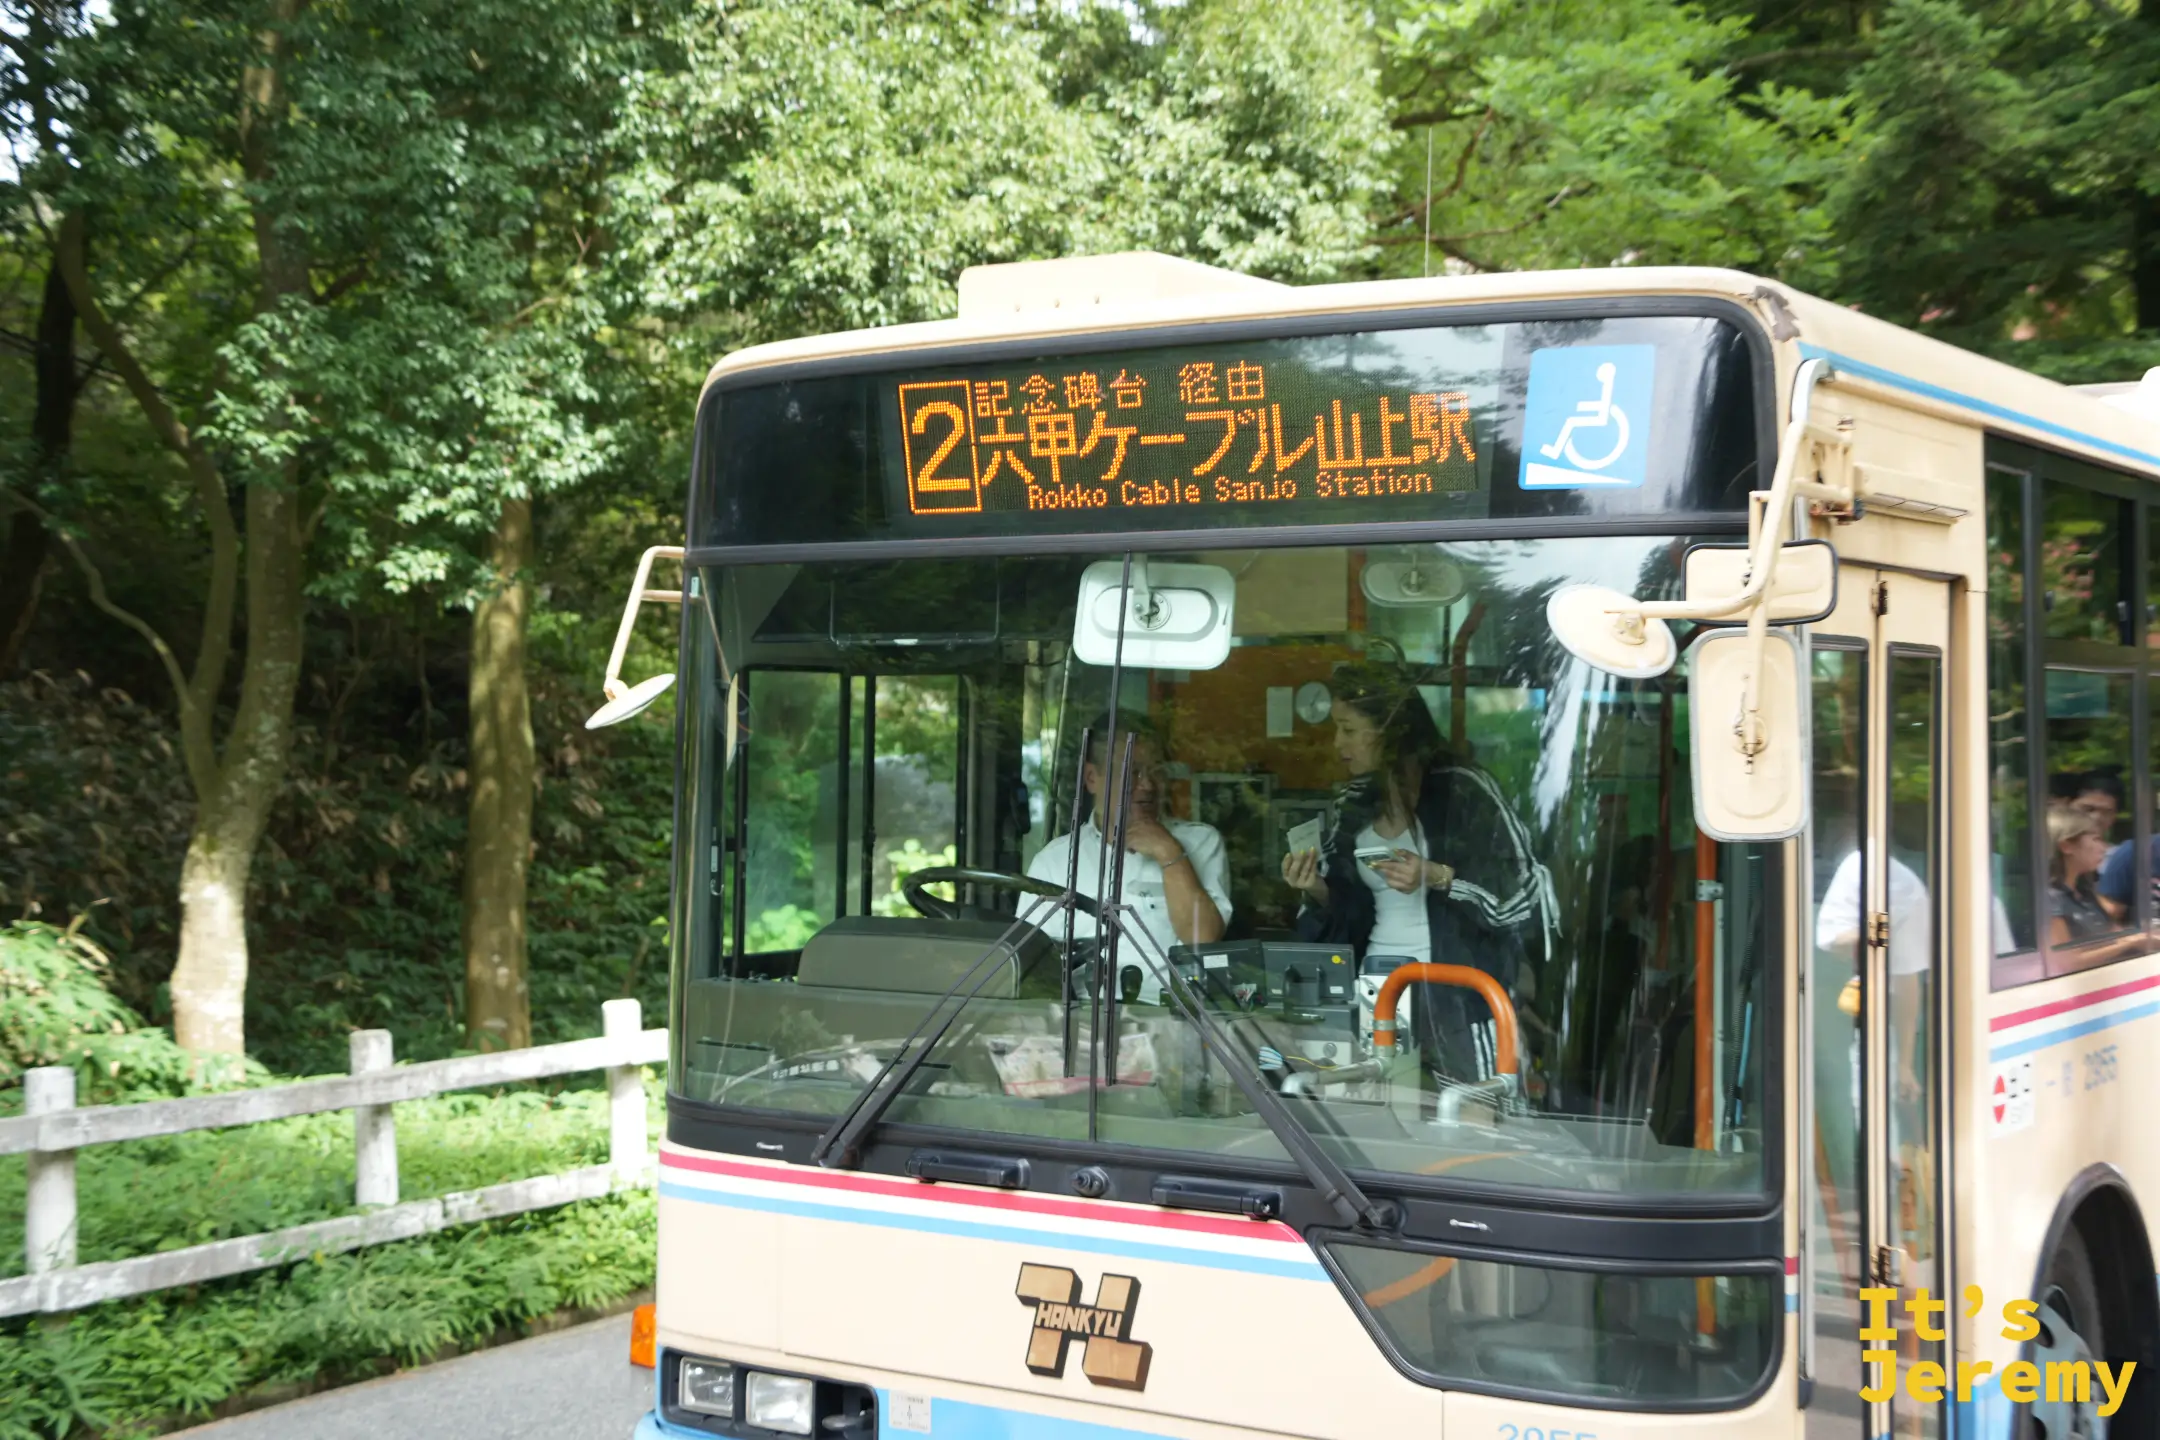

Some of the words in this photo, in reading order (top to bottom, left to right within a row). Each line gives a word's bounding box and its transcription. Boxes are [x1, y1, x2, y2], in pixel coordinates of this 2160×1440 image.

[974, 368, 1147, 417] 記念碑台
[1178, 360, 1265, 404] 経由
[911, 401, 971, 492] 2
[980, 390, 1476, 486] 六甲ケーブル山上駅
[1028, 482, 1107, 509] Rokko
[1121, 478, 1200, 505] Cable
[1215, 474, 1297, 502] Sanjo
[1316, 468, 1433, 497] Station
[1034, 1301, 1123, 1338] HANKYU
